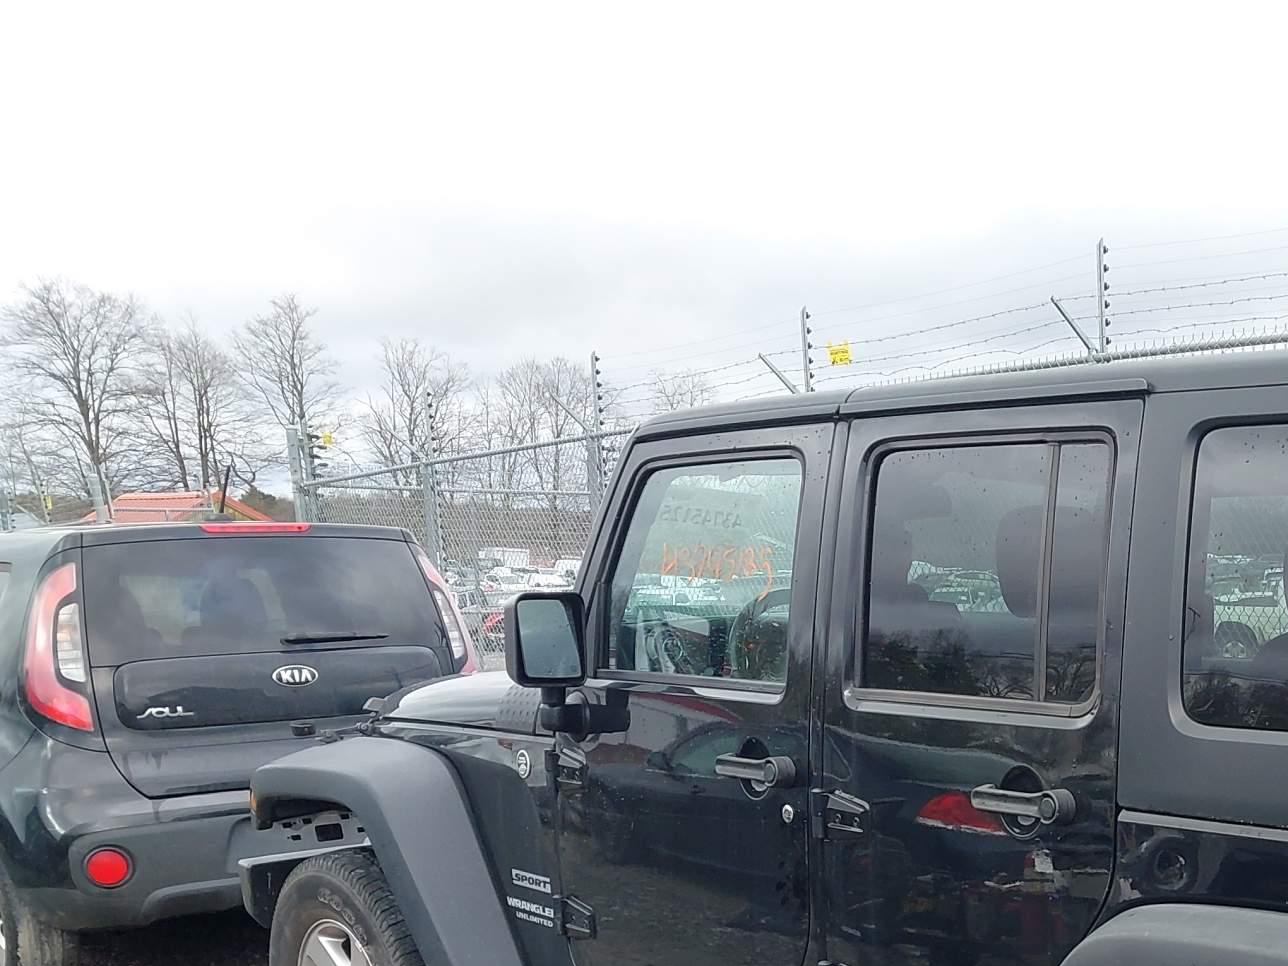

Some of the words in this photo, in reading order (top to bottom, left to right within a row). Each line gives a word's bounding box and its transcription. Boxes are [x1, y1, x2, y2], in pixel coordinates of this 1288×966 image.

[279, 669, 313, 684] KIA
[136, 706, 195, 719] SOUL
[514, 872, 551, 890] SPORT
[515, 910, 554, 928] UNLIMITED
